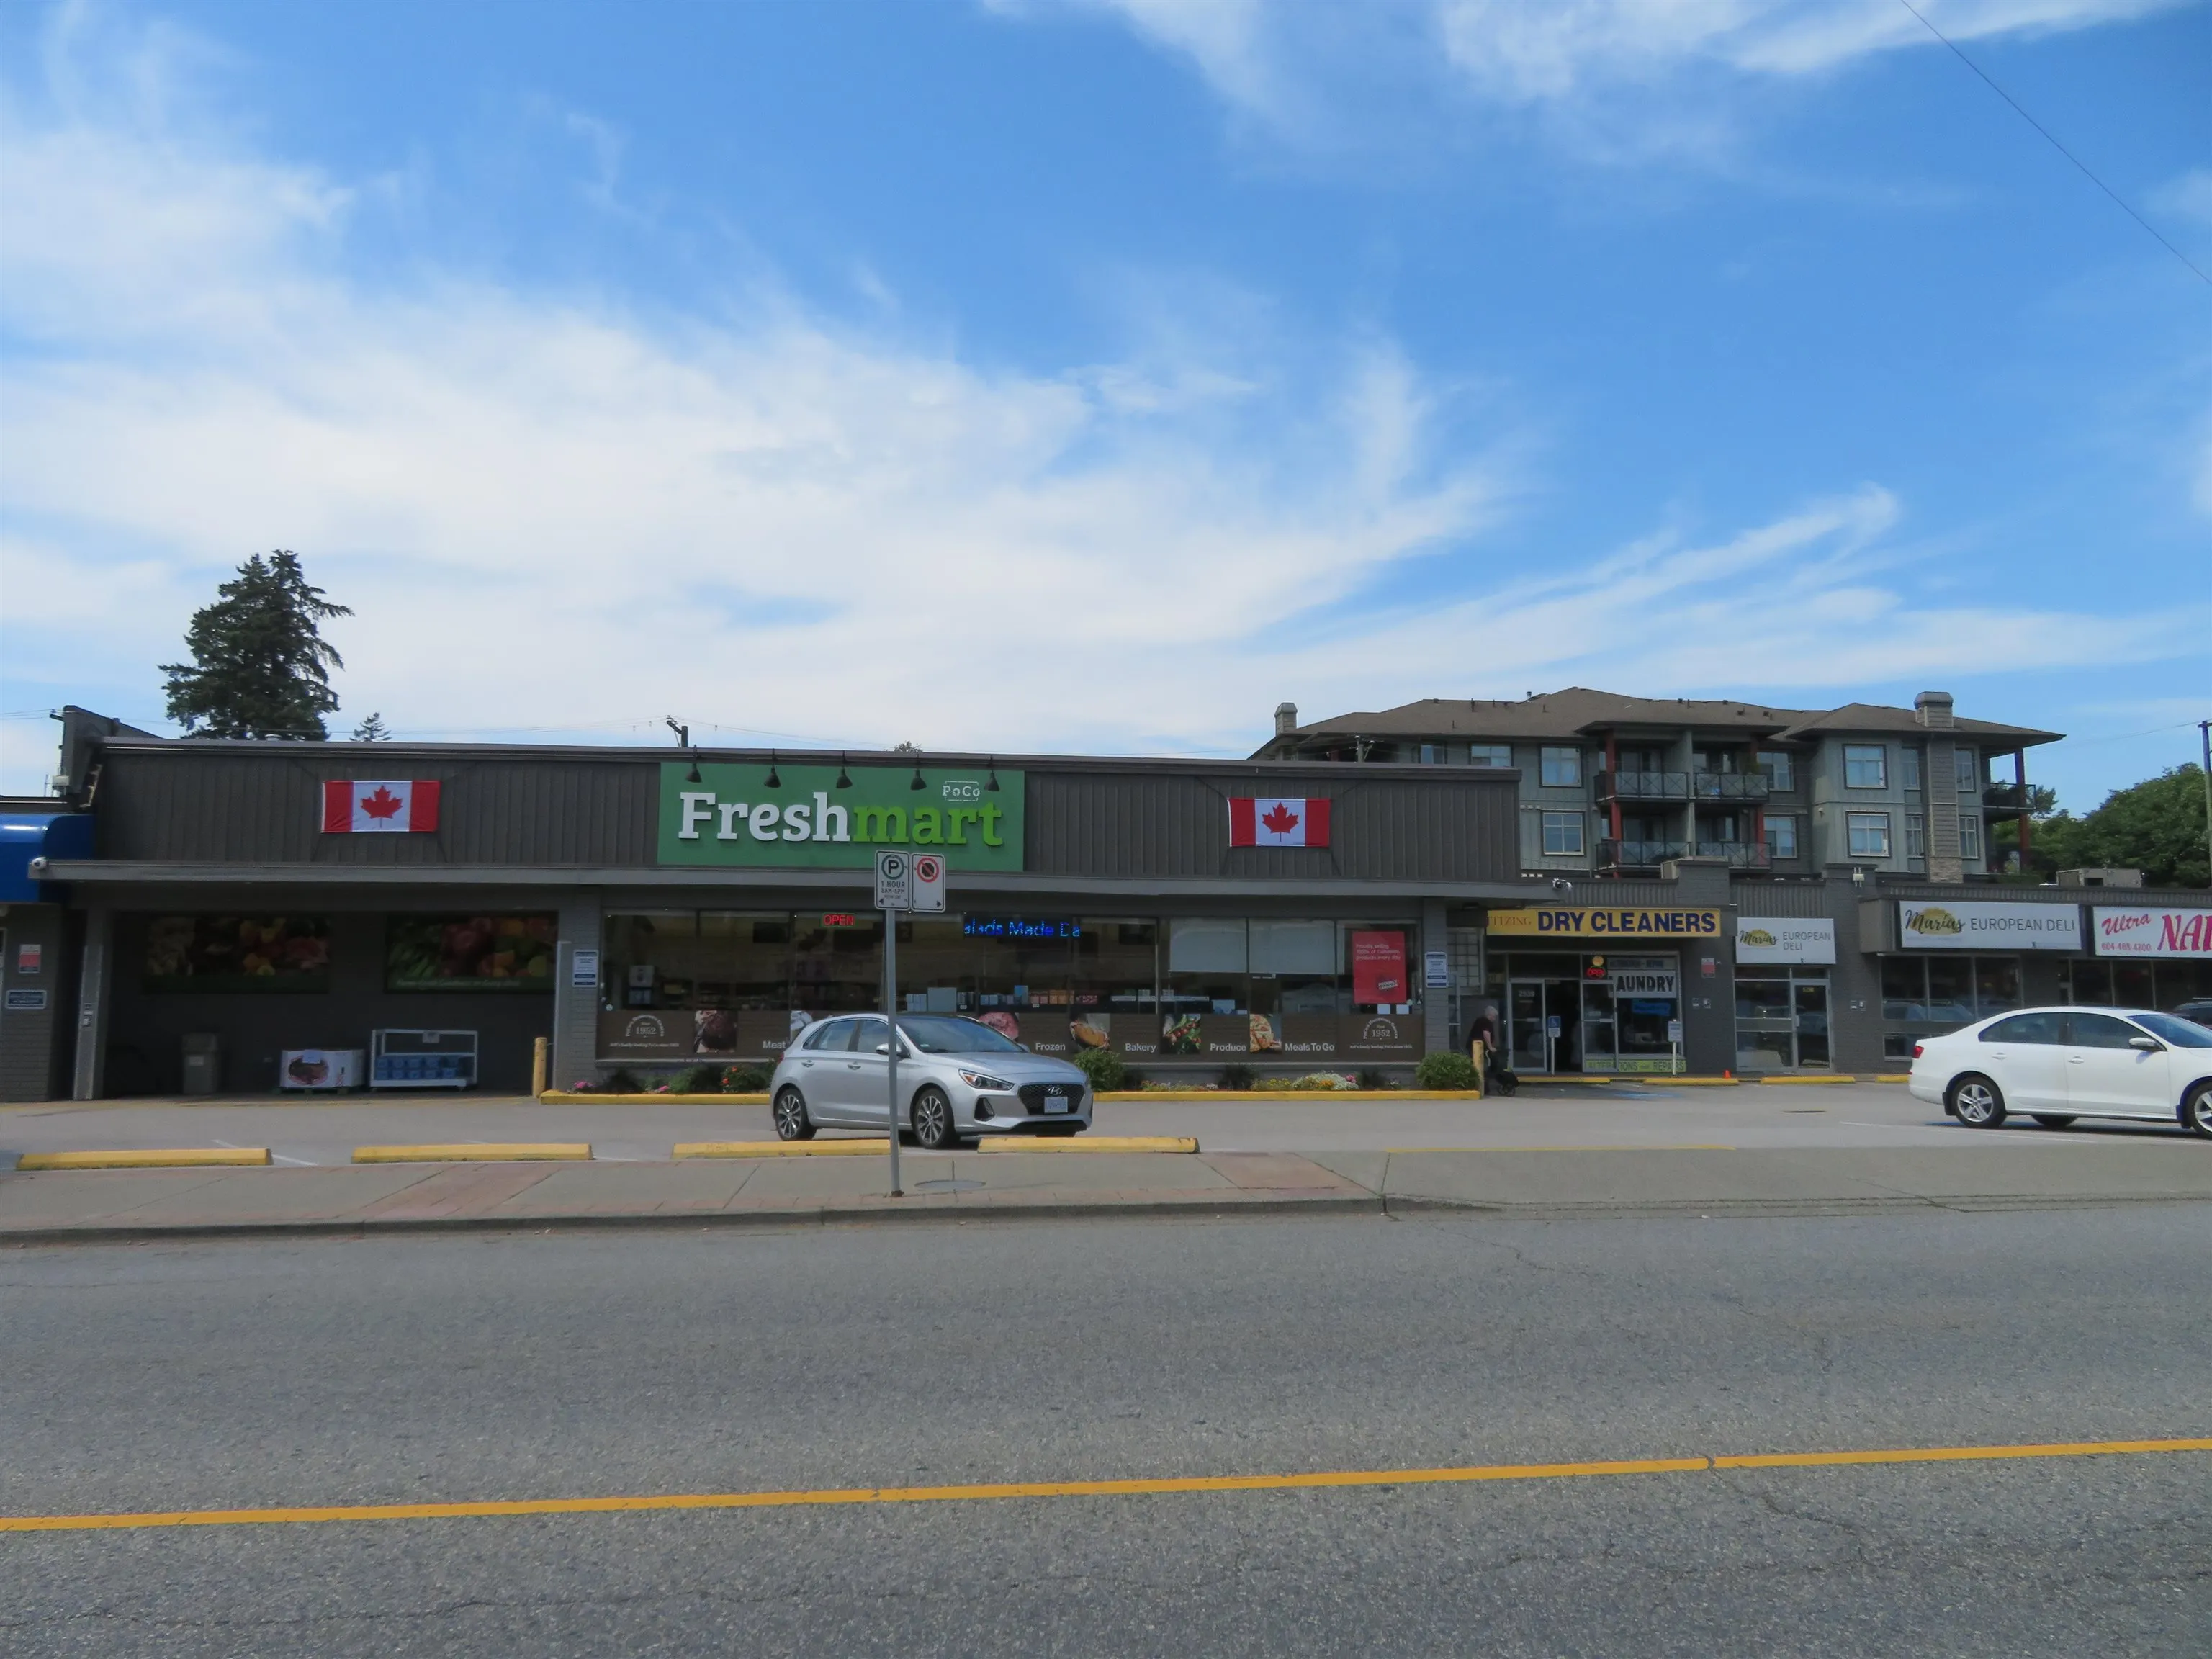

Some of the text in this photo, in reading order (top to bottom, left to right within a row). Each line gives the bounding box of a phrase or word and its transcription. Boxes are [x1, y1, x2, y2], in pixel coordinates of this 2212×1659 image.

[942, 784, 981, 797] PoCo
[678, 792, 1004, 846] Freshmart
[823, 914, 853, 926] OPEN
[1537, 911, 1586, 932] DRY
[1590, 911, 1717, 932] CLEANERS
[1970, 917, 2043, 932] EUROPEAN
[2046, 918, 2075, 932] DELI
[2100, 913, 2152, 936] Ultra
[1783, 931, 1831, 941] EUROPEAN
[1783, 942, 1803, 950] DELI
[636, 1026, 657, 1035] 1952
[763, 1040, 786, 1049] Meat
[1035, 1043, 1066, 1051] Frozen
[1125, 1043, 1156, 1053] Bakery
[1210, 1043, 1247, 1051] Produce
[1285, 1043, 1335, 1051] Meals To Go
